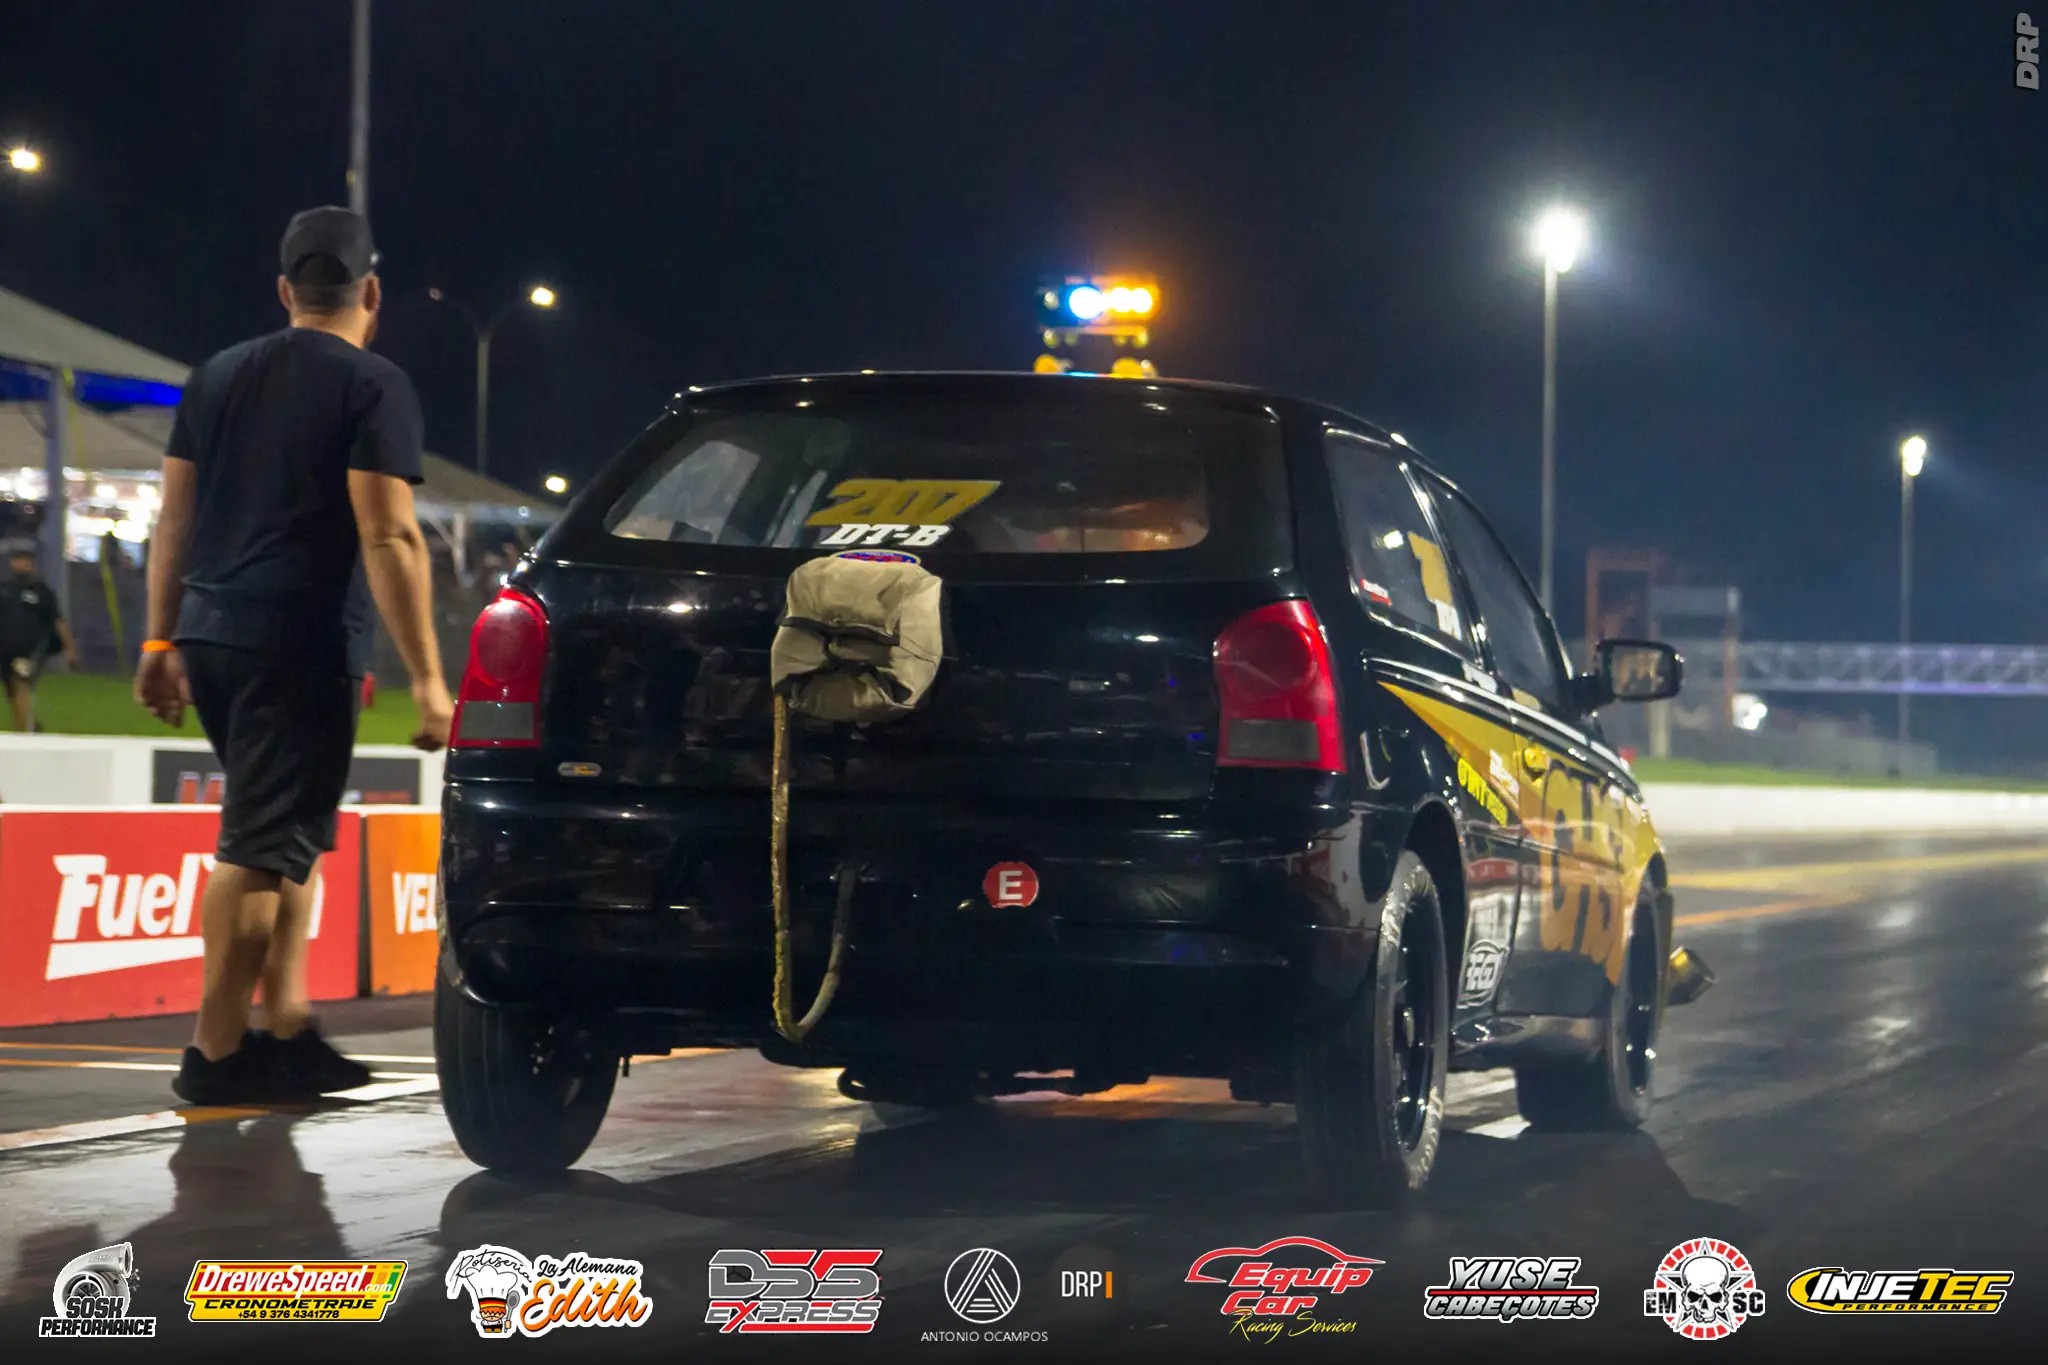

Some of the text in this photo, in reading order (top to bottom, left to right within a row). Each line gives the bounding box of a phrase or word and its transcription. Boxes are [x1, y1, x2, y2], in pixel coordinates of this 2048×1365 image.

[805, 478, 1003, 525] 207
[821, 524, 952, 546] DT-B
[999, 870, 1023, 900] E
